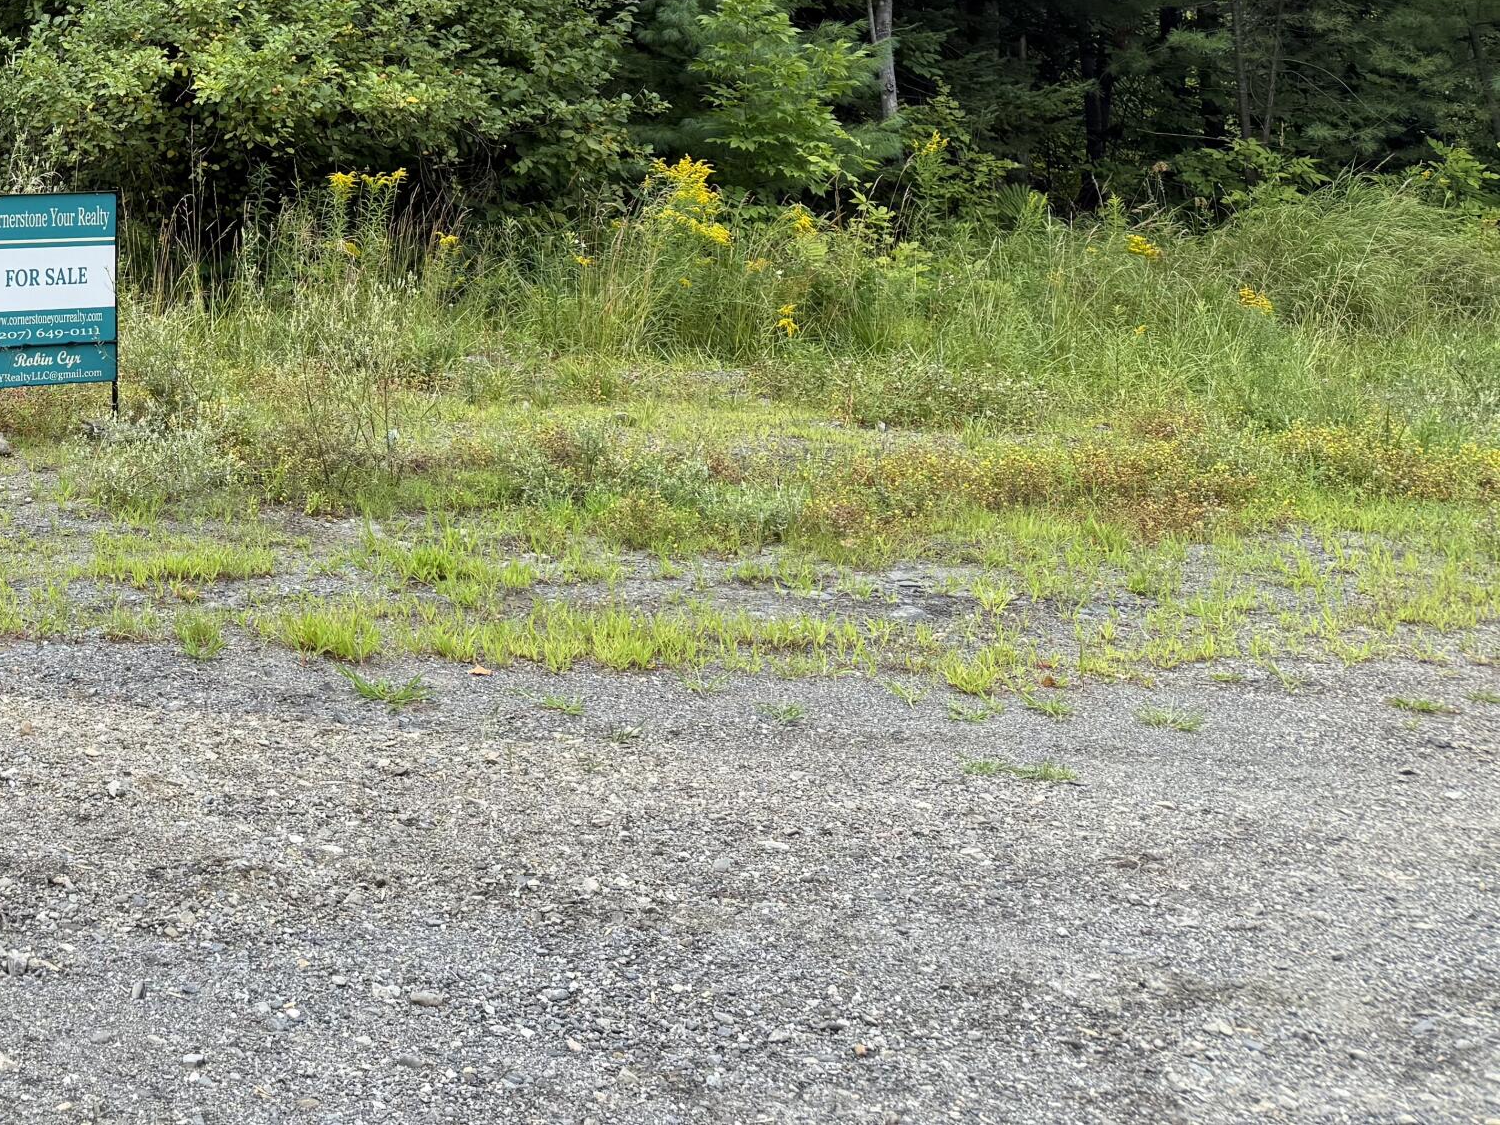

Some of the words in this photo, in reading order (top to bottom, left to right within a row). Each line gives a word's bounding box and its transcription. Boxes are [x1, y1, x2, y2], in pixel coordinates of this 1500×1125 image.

[49, 207, 76, 227] Your
[77, 205, 110, 230] Realty
[5, 268, 41, 288] FOR
[45, 266, 88, 286] SALE
[36, 326, 101, 339] 649-0111
[13, 352, 54, 368] Robin
[57, 350, 82, 369] Cyr
